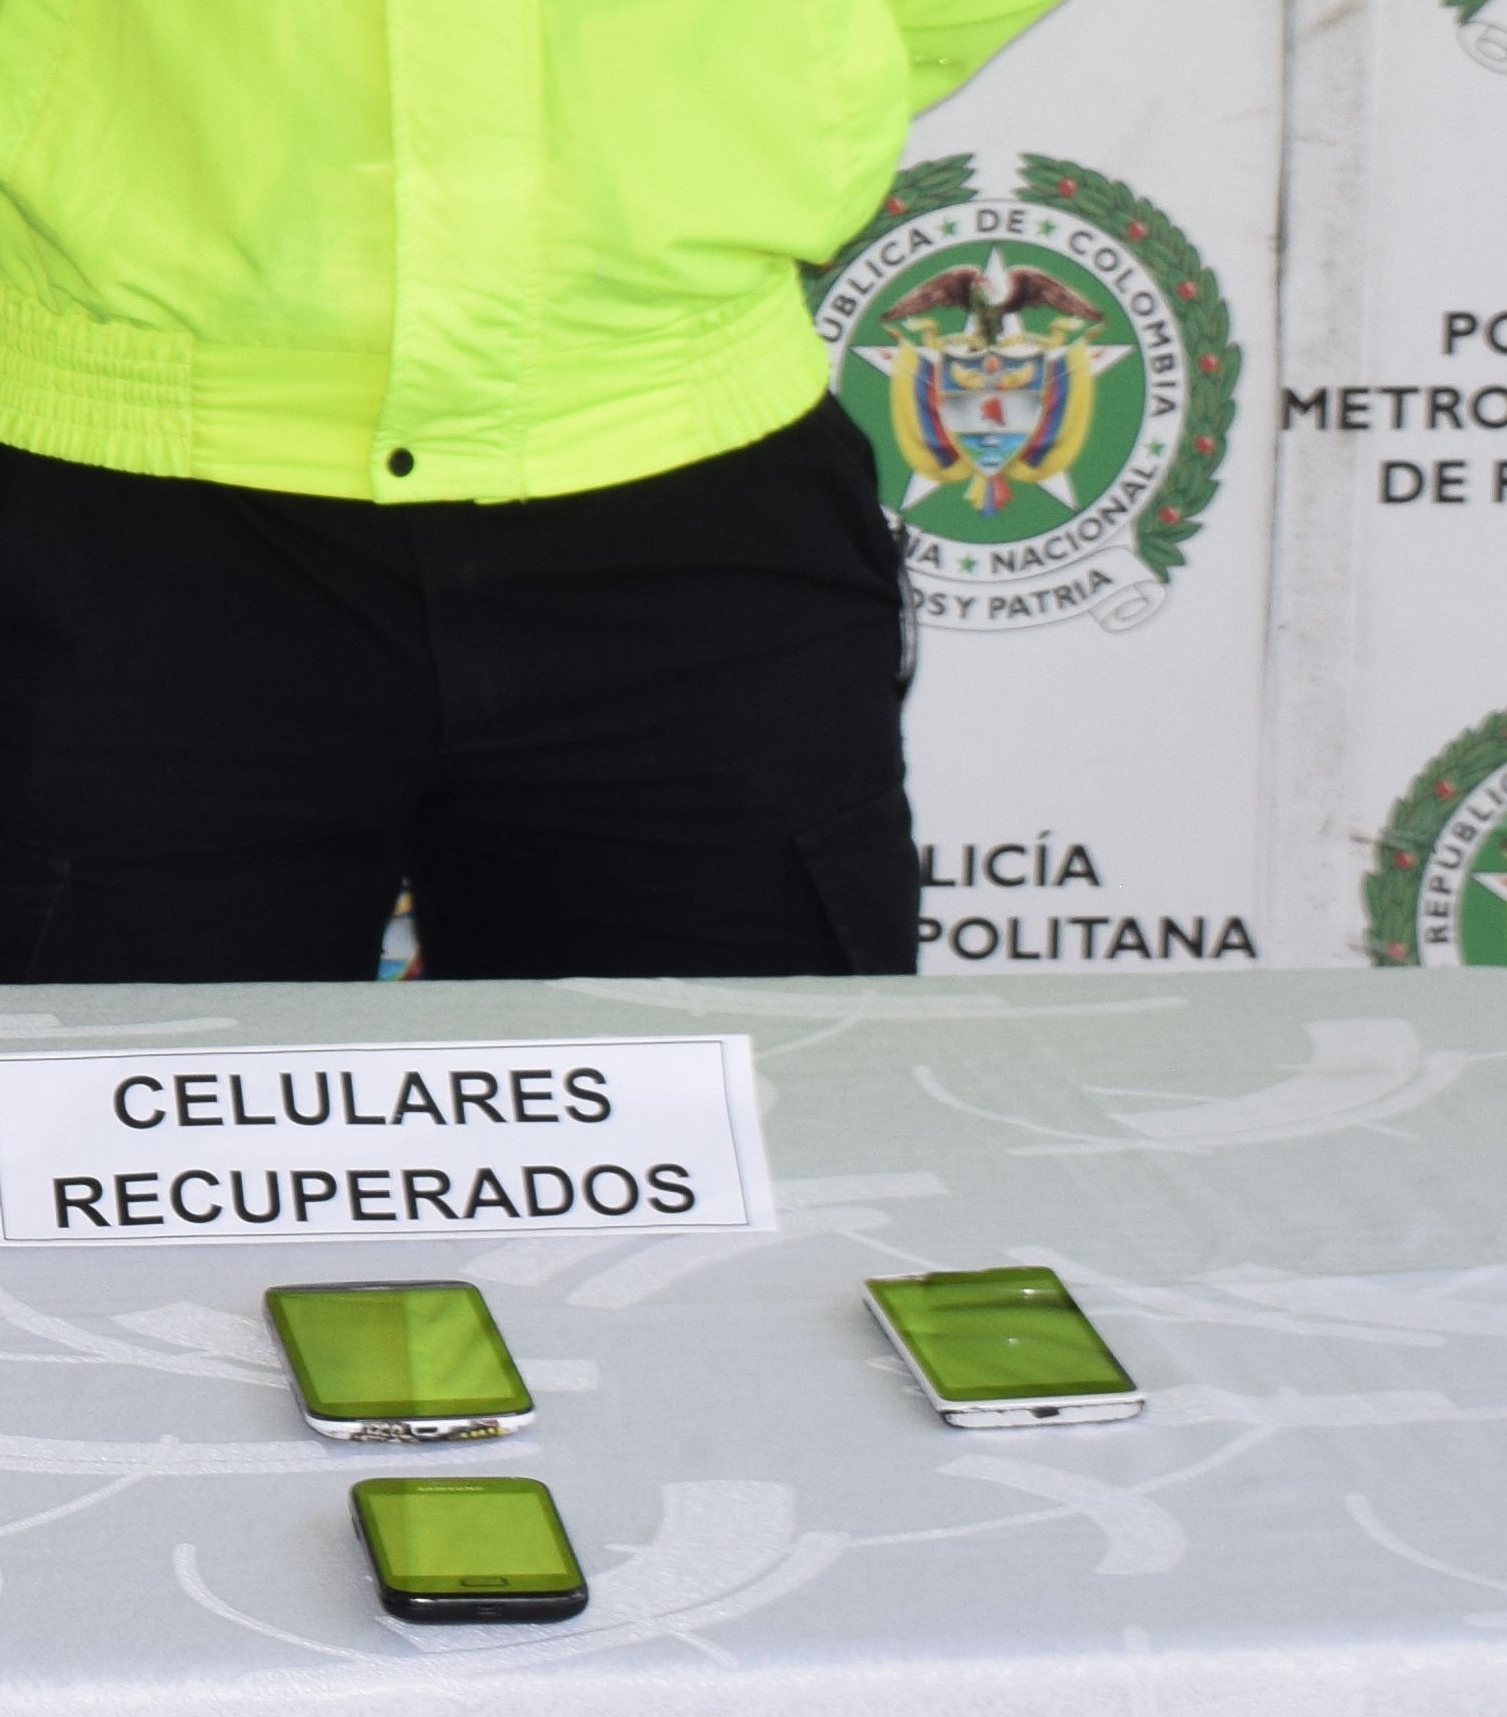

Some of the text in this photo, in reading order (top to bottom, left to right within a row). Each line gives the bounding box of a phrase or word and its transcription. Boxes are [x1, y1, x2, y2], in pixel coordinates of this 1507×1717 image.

[976, 209, 1026, 235] DE
[1068, 231, 1179, 417] COLOMBIA
[1381, 461, 1466, 503] DE
[990, 462, 1156, 574] NACIONAL
[989, 568, 1113, 620] PATRIA
[114, 1068, 612, 1130] CELULARES
[52, 1164, 697, 1229] RECUPERADOS
